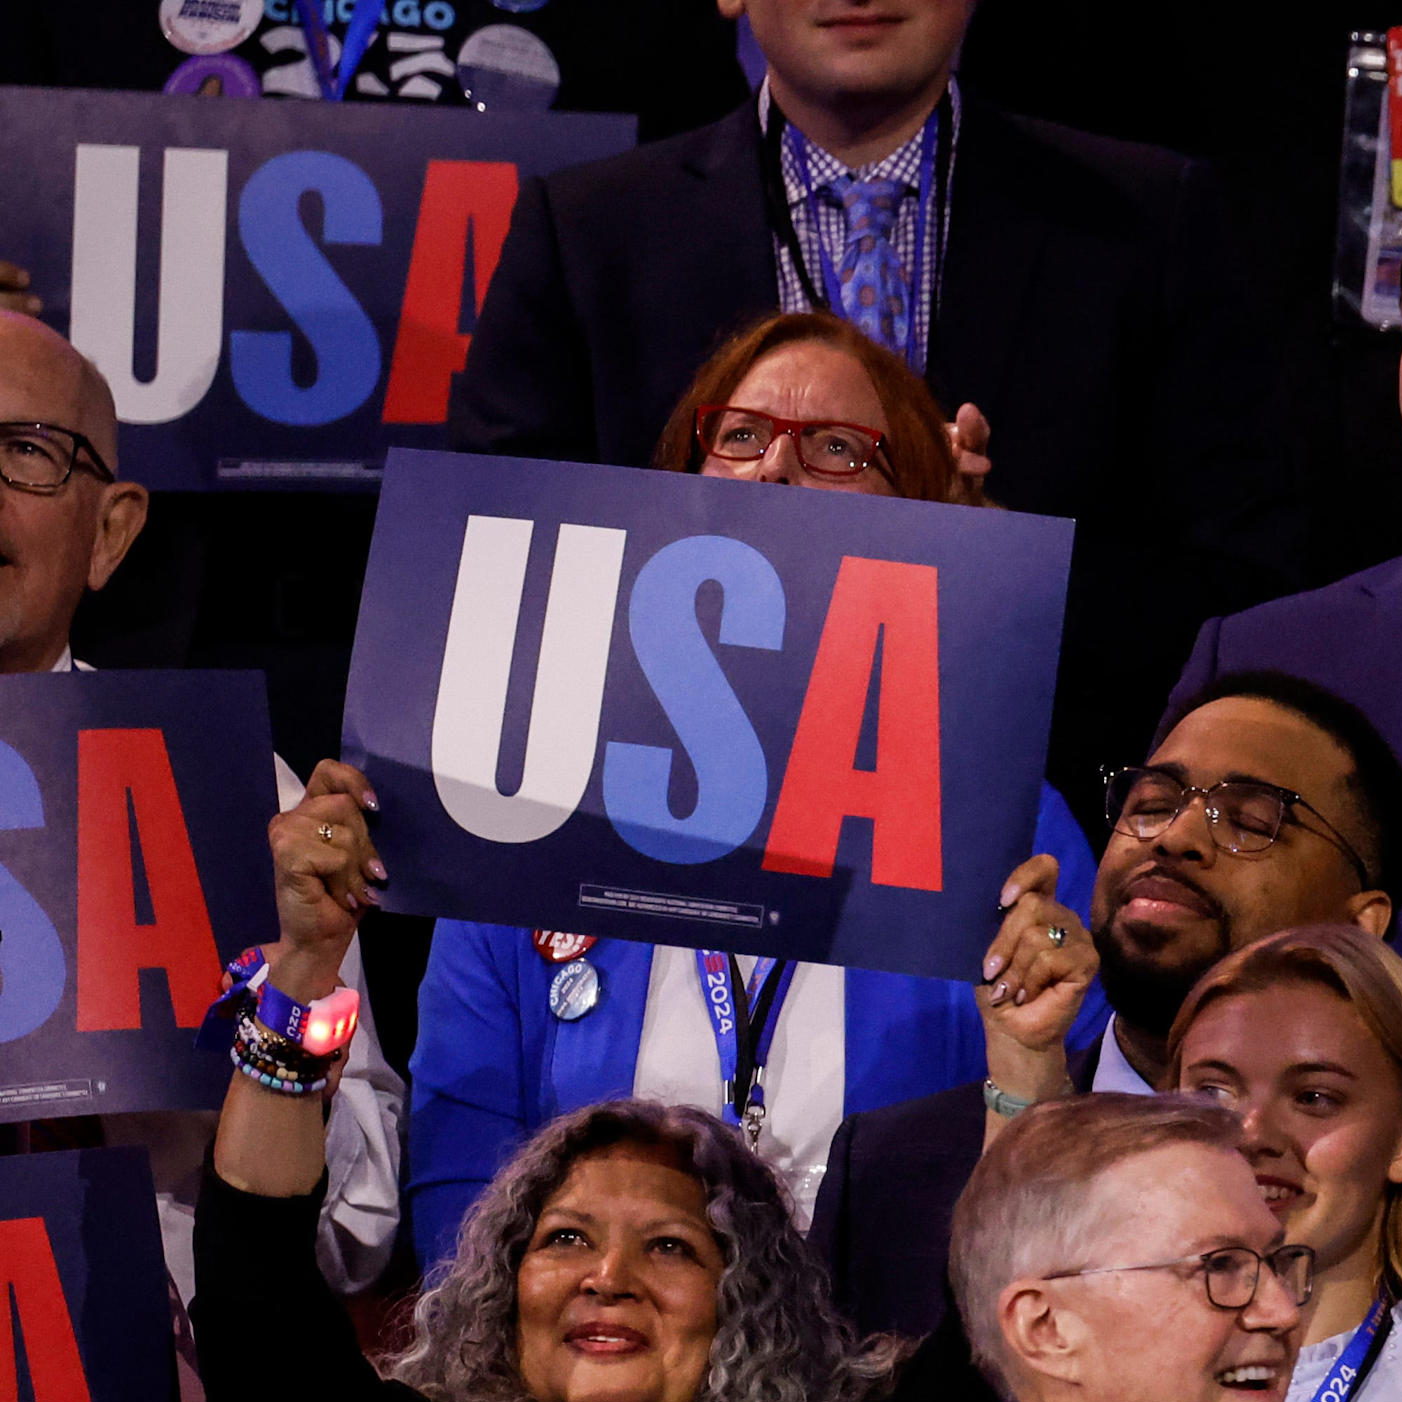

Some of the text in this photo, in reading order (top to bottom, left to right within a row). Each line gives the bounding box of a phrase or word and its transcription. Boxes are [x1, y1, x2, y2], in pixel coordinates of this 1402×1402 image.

[70, 143, 518, 425] USA
[431, 514, 942, 892] USA
[550, 964, 582, 1006] CHICAGO
[707, 972, 732, 1034] 2024
[286, 1006, 301, 1037] DNC
